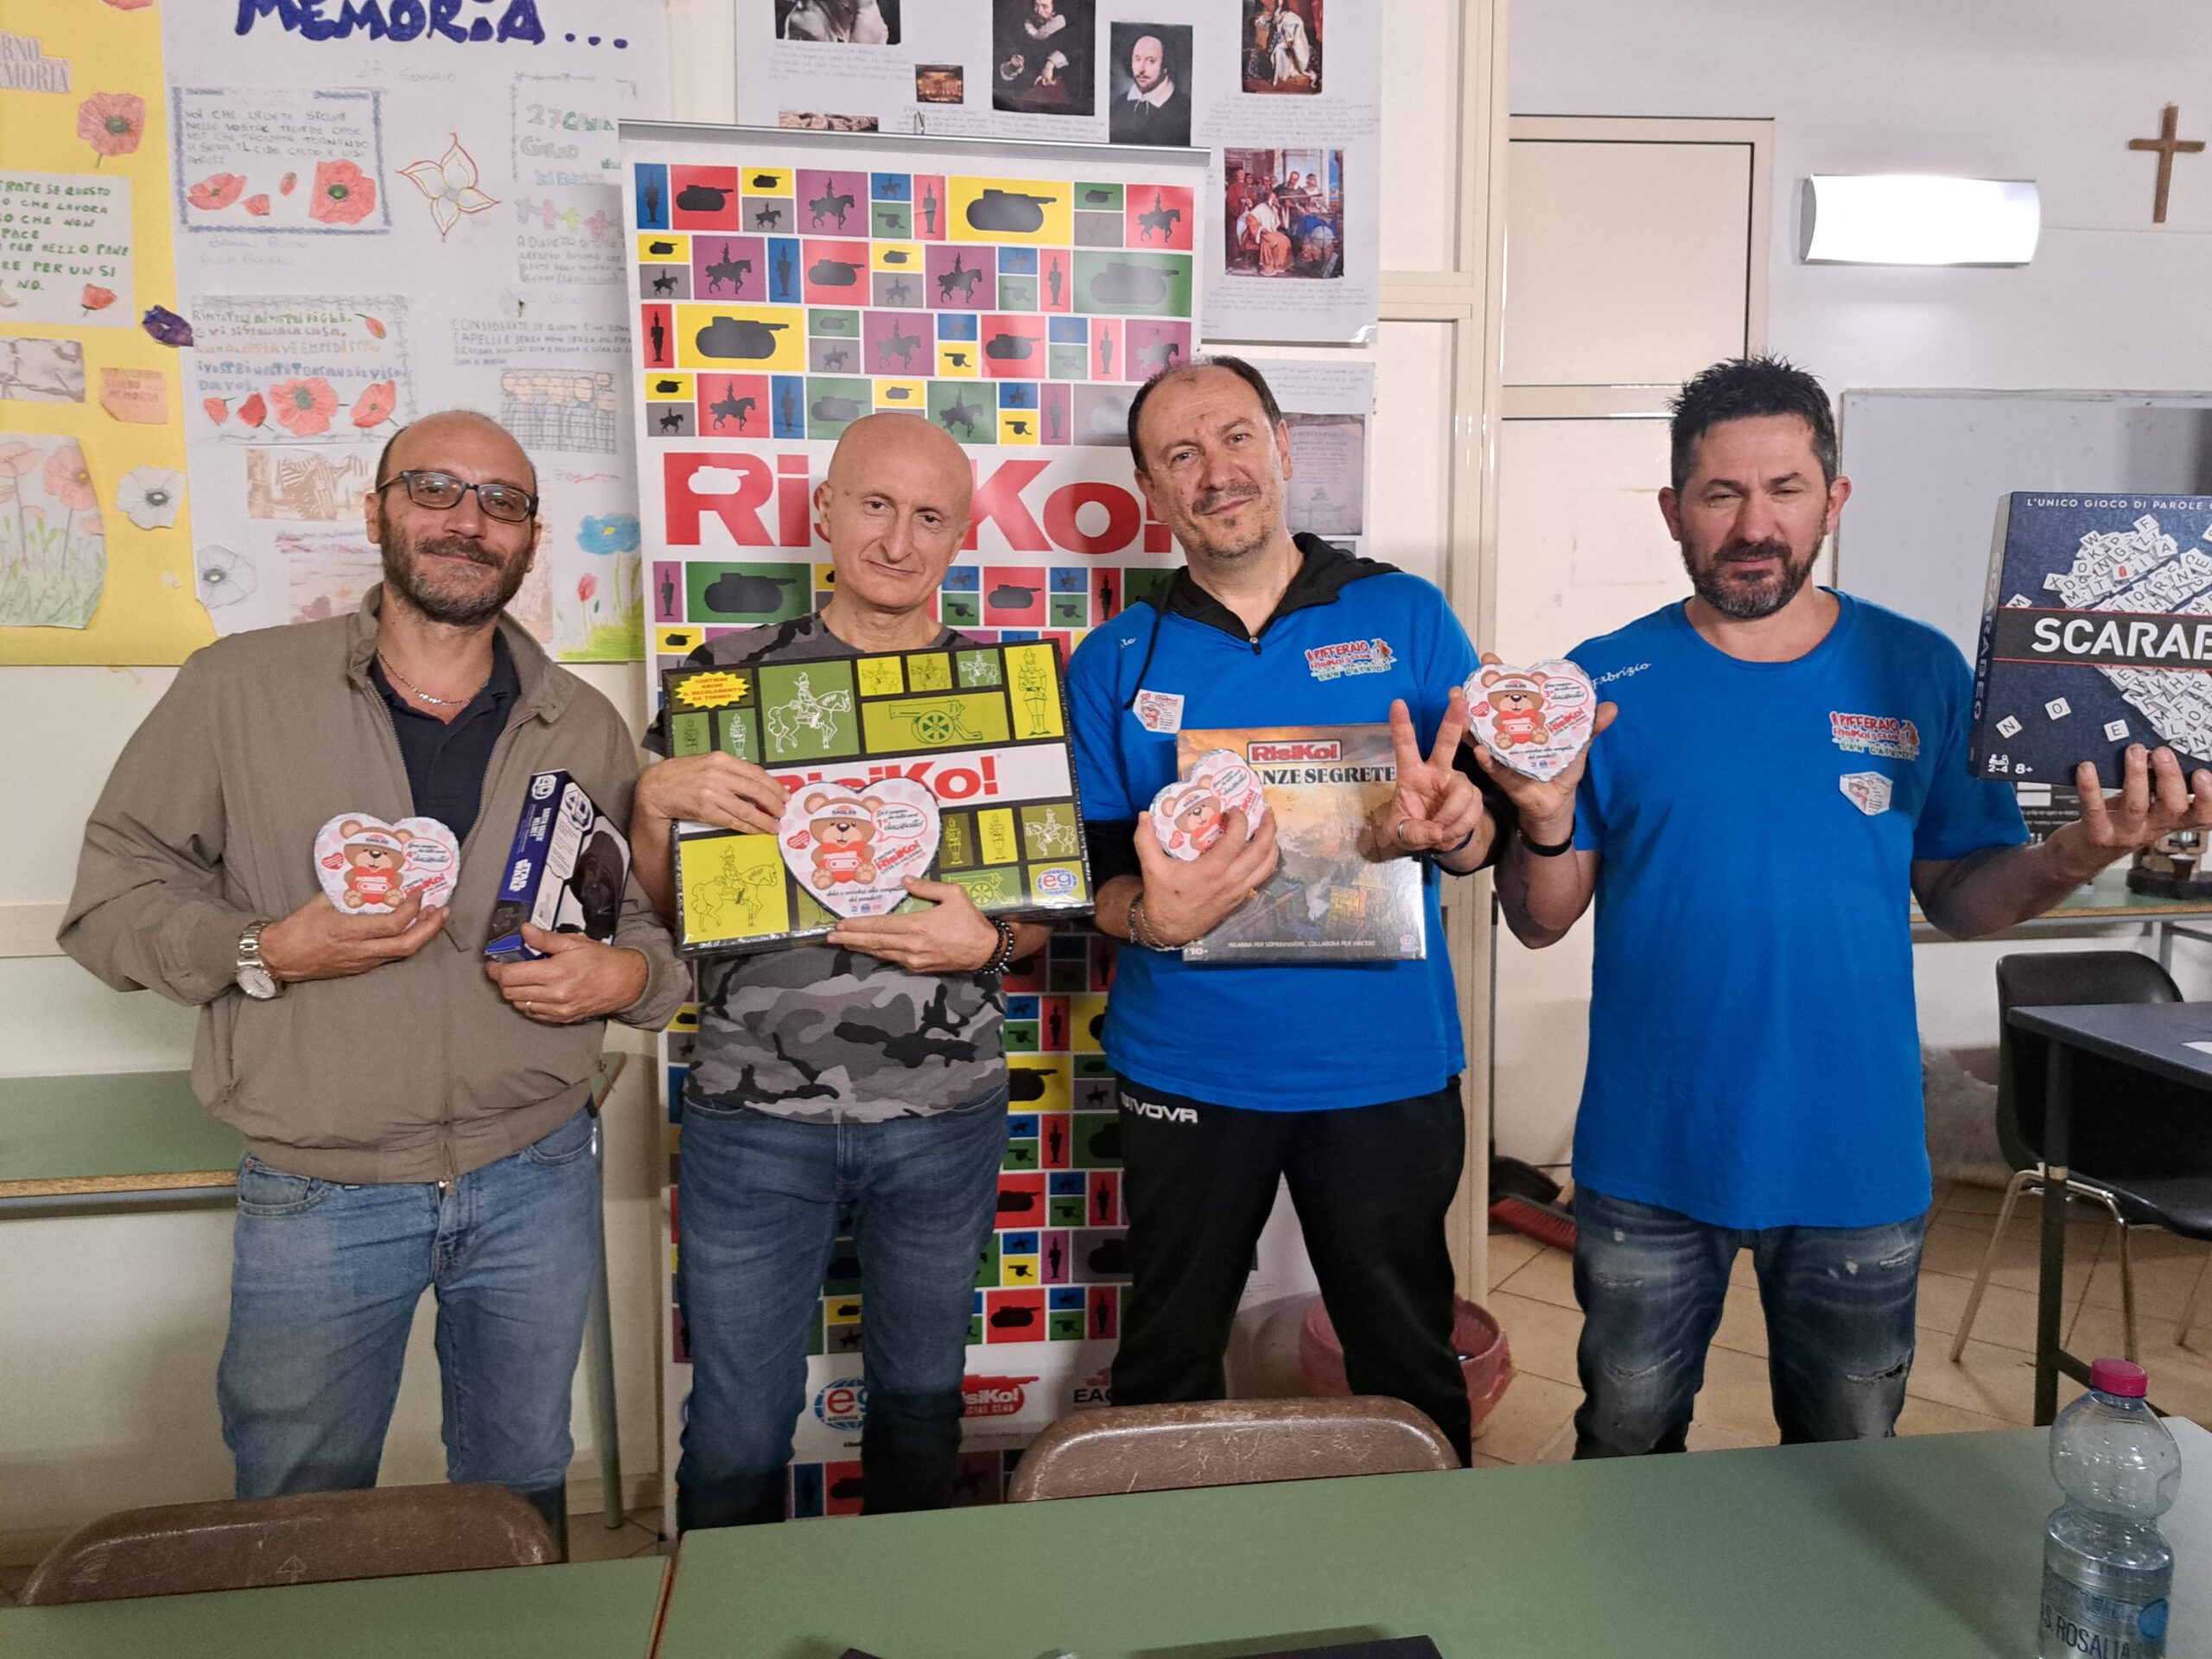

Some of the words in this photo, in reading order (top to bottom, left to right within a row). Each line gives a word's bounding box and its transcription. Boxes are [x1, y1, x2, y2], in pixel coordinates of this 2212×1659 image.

[664, 452, 1172, 560] RiKo!
[2027, 499, 2079, 509] L'UNICO
[2084, 499, 2128, 510] GIOCO
[2133, 500, 2147, 510] DI
[2152, 501, 2203, 512] PAROLE
[2162, 543, 2172, 553] A
[1314, 641, 1369, 659] PIFFERAIO
[1318, 671, 1341, 681] SAN
[1839, 714, 1900, 732] PIFFERAIO
[2003, 720, 2015, 734] N
[2110, 723, 2123, 737] E
[1250, 743, 1338, 762] RisiKo!
[1304, 766, 1397, 785] SEGRETE
[1987, 764, 2009, 773] 2-4
[2014, 763, 2033, 775] 8+
